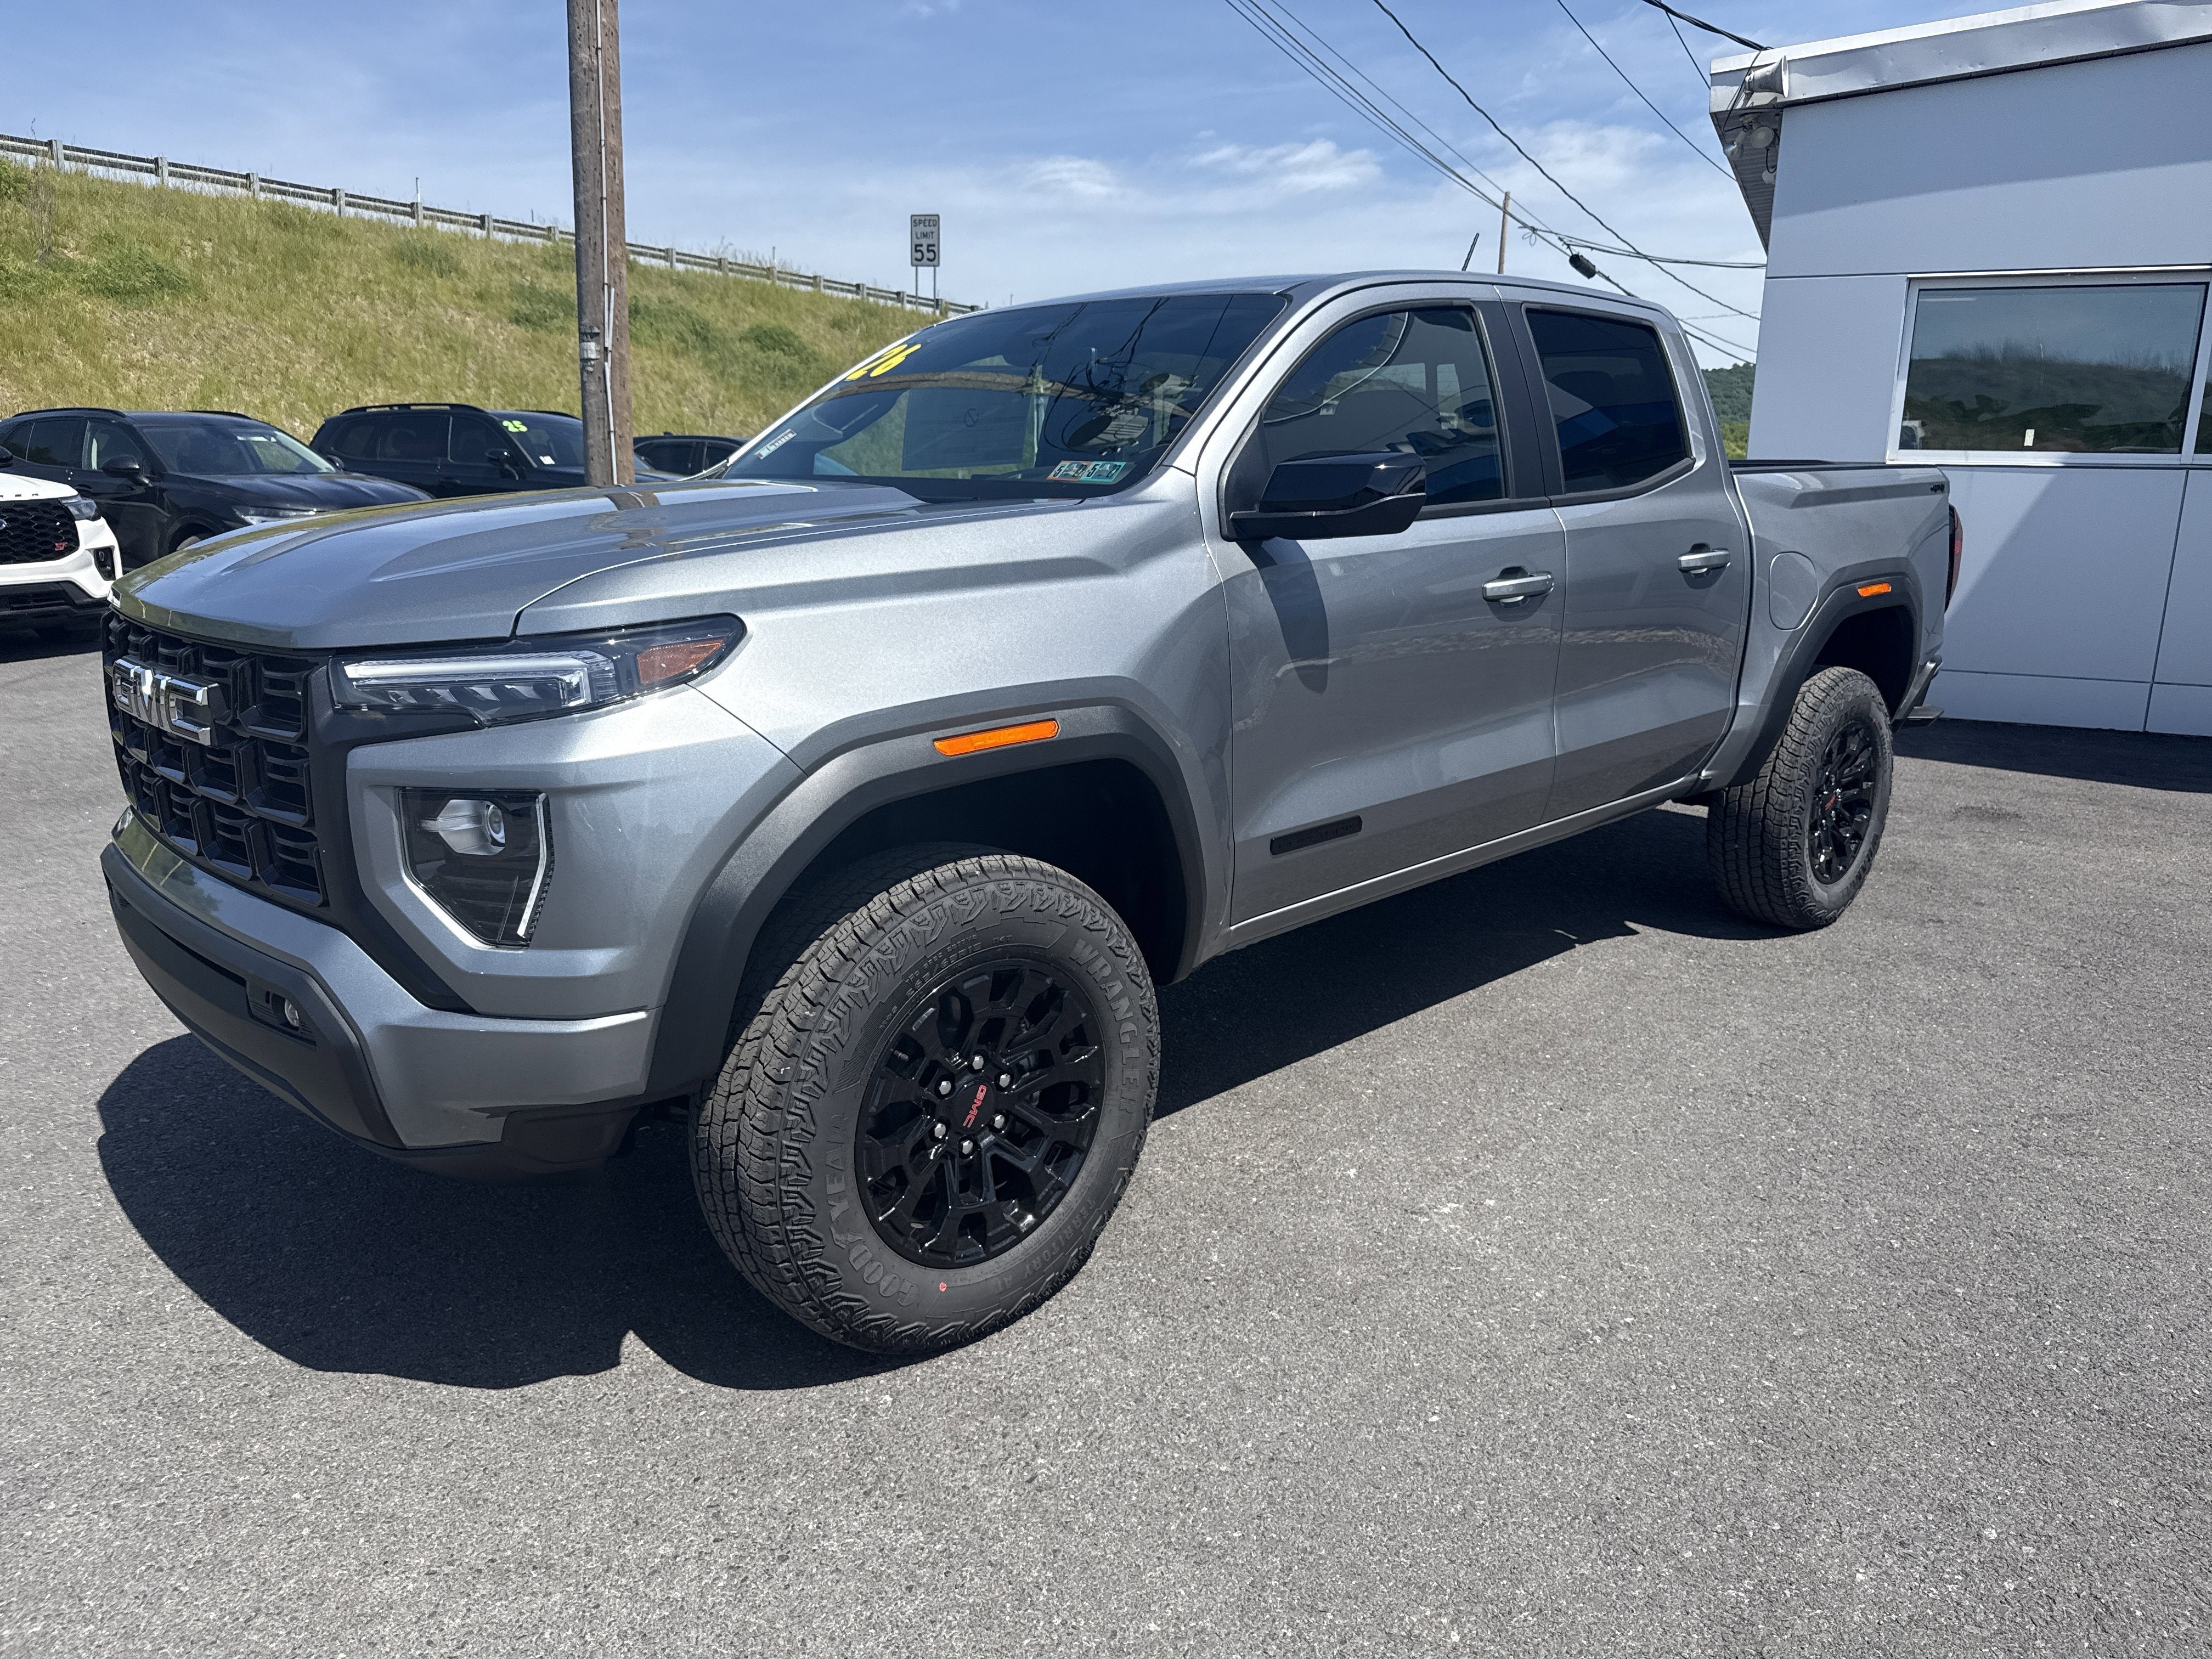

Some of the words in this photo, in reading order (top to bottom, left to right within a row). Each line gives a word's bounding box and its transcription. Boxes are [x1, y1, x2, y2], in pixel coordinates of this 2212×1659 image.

[913, 219, 938, 228] SPEED
[915, 231, 935, 240] LIMIT
[914, 244, 936, 262] 55
[844, 343, 921, 381] 26
[502, 420, 528, 432] 25
[1053, 466, 1064, 477] 5
[1087, 464, 1099, 477] 5
[112, 658, 212, 747] GMC
[1069, 939, 1141, 1114] WRANGLER
[963, 1085, 987, 1127] GMC
[1025, 1198, 1097, 1279] TERRITORY
